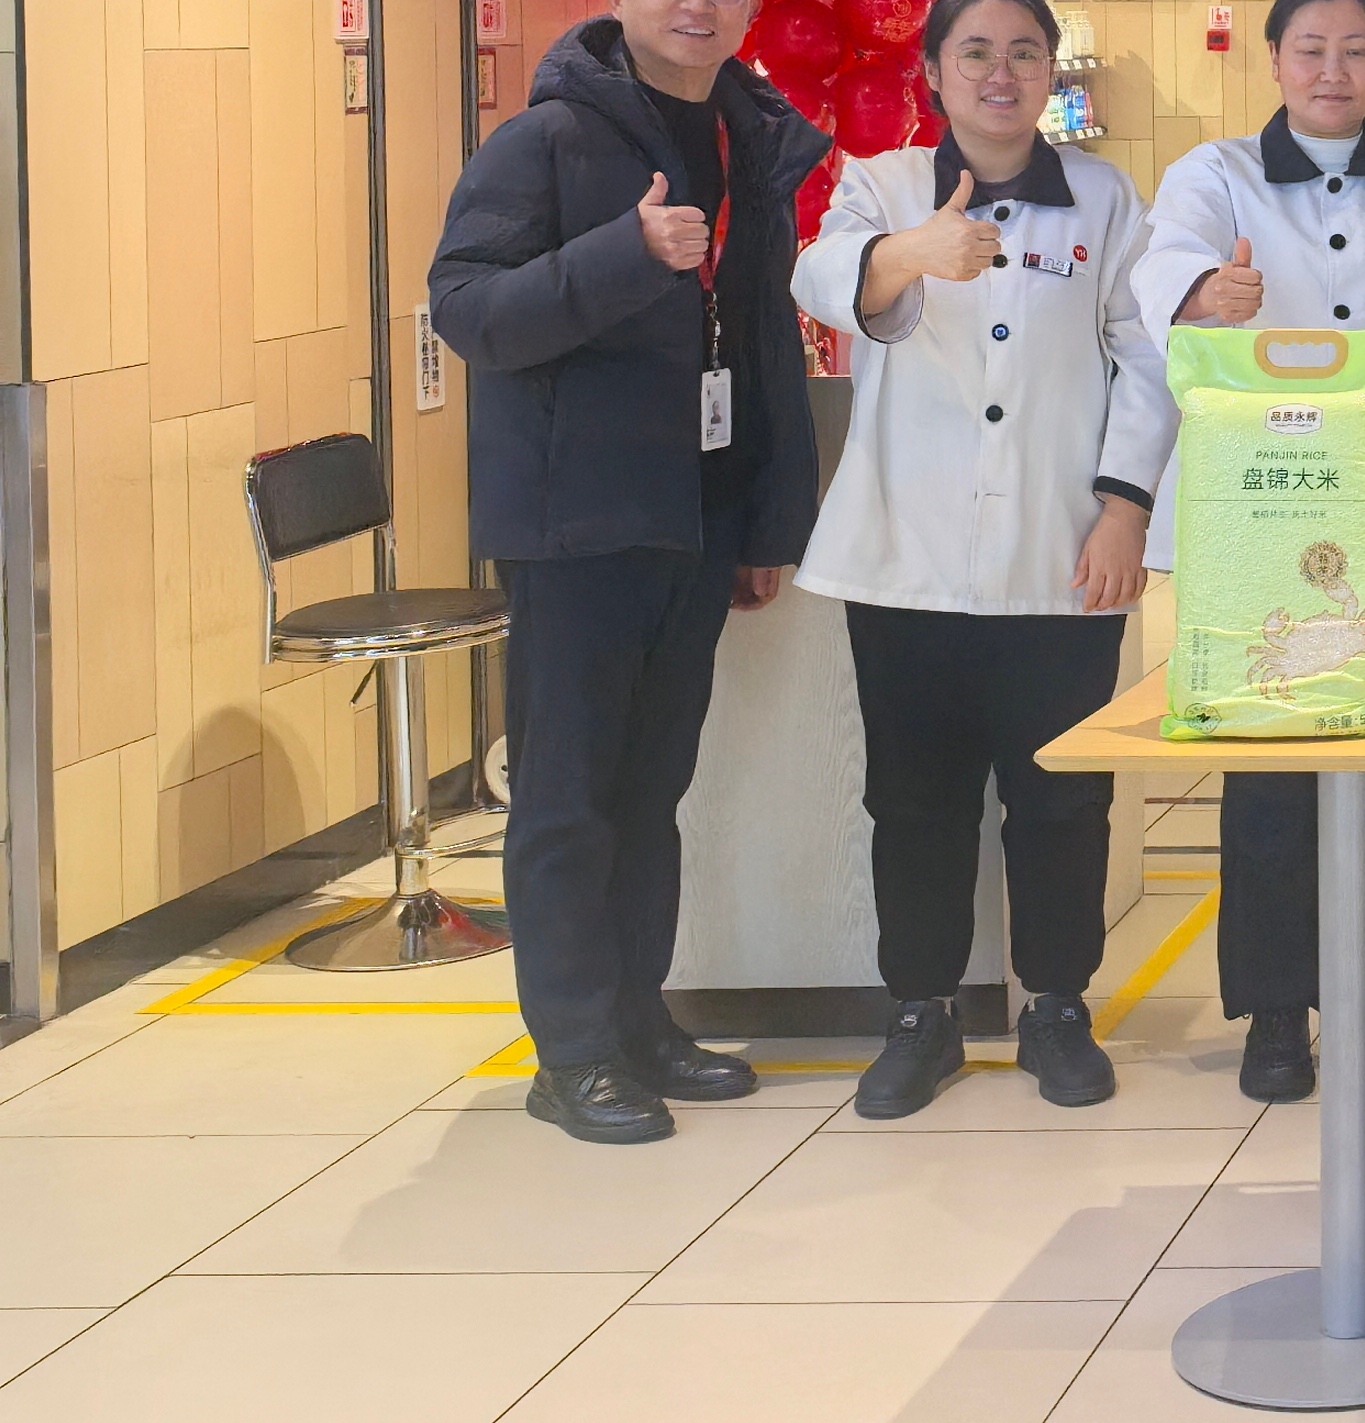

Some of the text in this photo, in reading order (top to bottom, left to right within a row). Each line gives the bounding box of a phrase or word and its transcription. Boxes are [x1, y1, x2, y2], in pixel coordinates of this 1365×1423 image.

[1270, 411, 1318, 423] 品质永辉
[1256, 451, 1328, 460] PANJIN RICE
[1241, 467, 1341, 492] 盘锦大米
